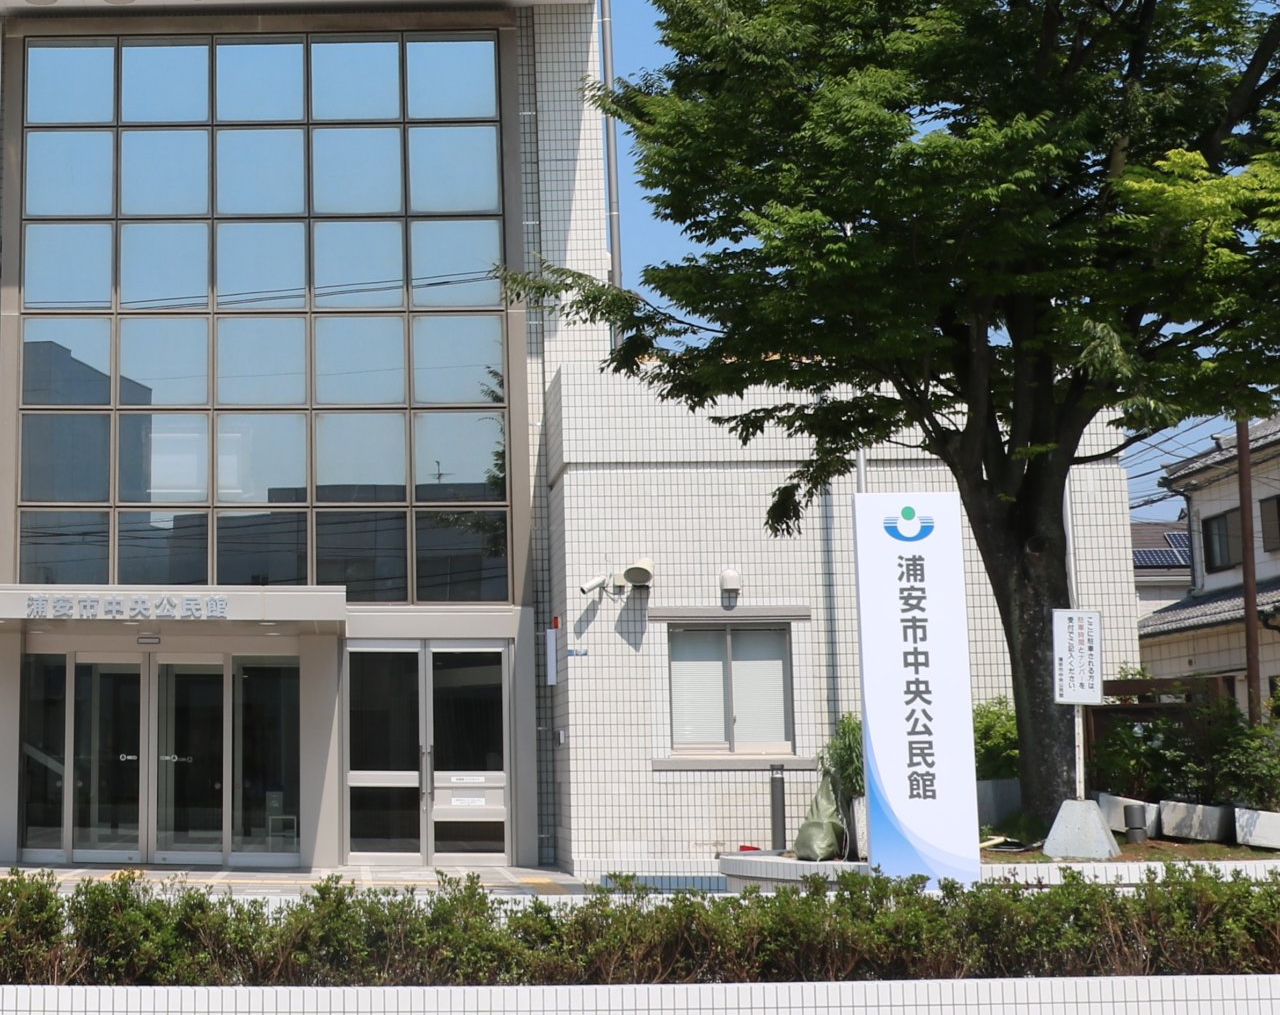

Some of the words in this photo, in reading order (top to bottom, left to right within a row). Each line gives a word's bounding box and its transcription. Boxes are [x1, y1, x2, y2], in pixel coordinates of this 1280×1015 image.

[27, 595, 228, 619] 浦安市中央公民館
[897, 555, 936, 800] 浦安市中央公民館
